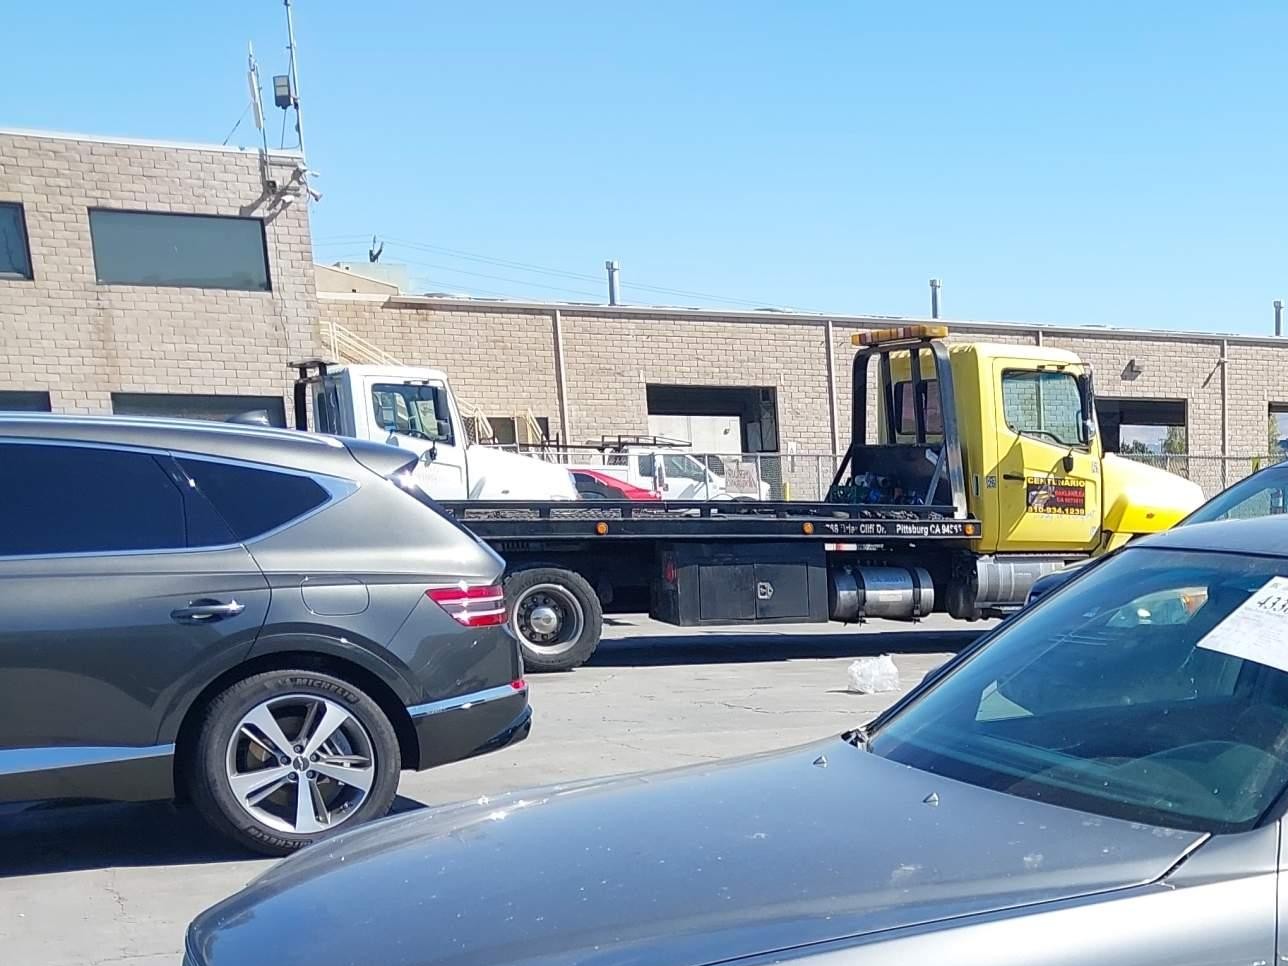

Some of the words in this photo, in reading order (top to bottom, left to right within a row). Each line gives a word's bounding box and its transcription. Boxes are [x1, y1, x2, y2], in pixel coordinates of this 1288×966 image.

[860, 523, 875, 534] Cliff
[876, 523, 887, 534] Dr.
[896, 523, 929, 536] Pittsburg
[930, 524, 941, 534] CA
[295, 677, 361, 704] MICHELIN
